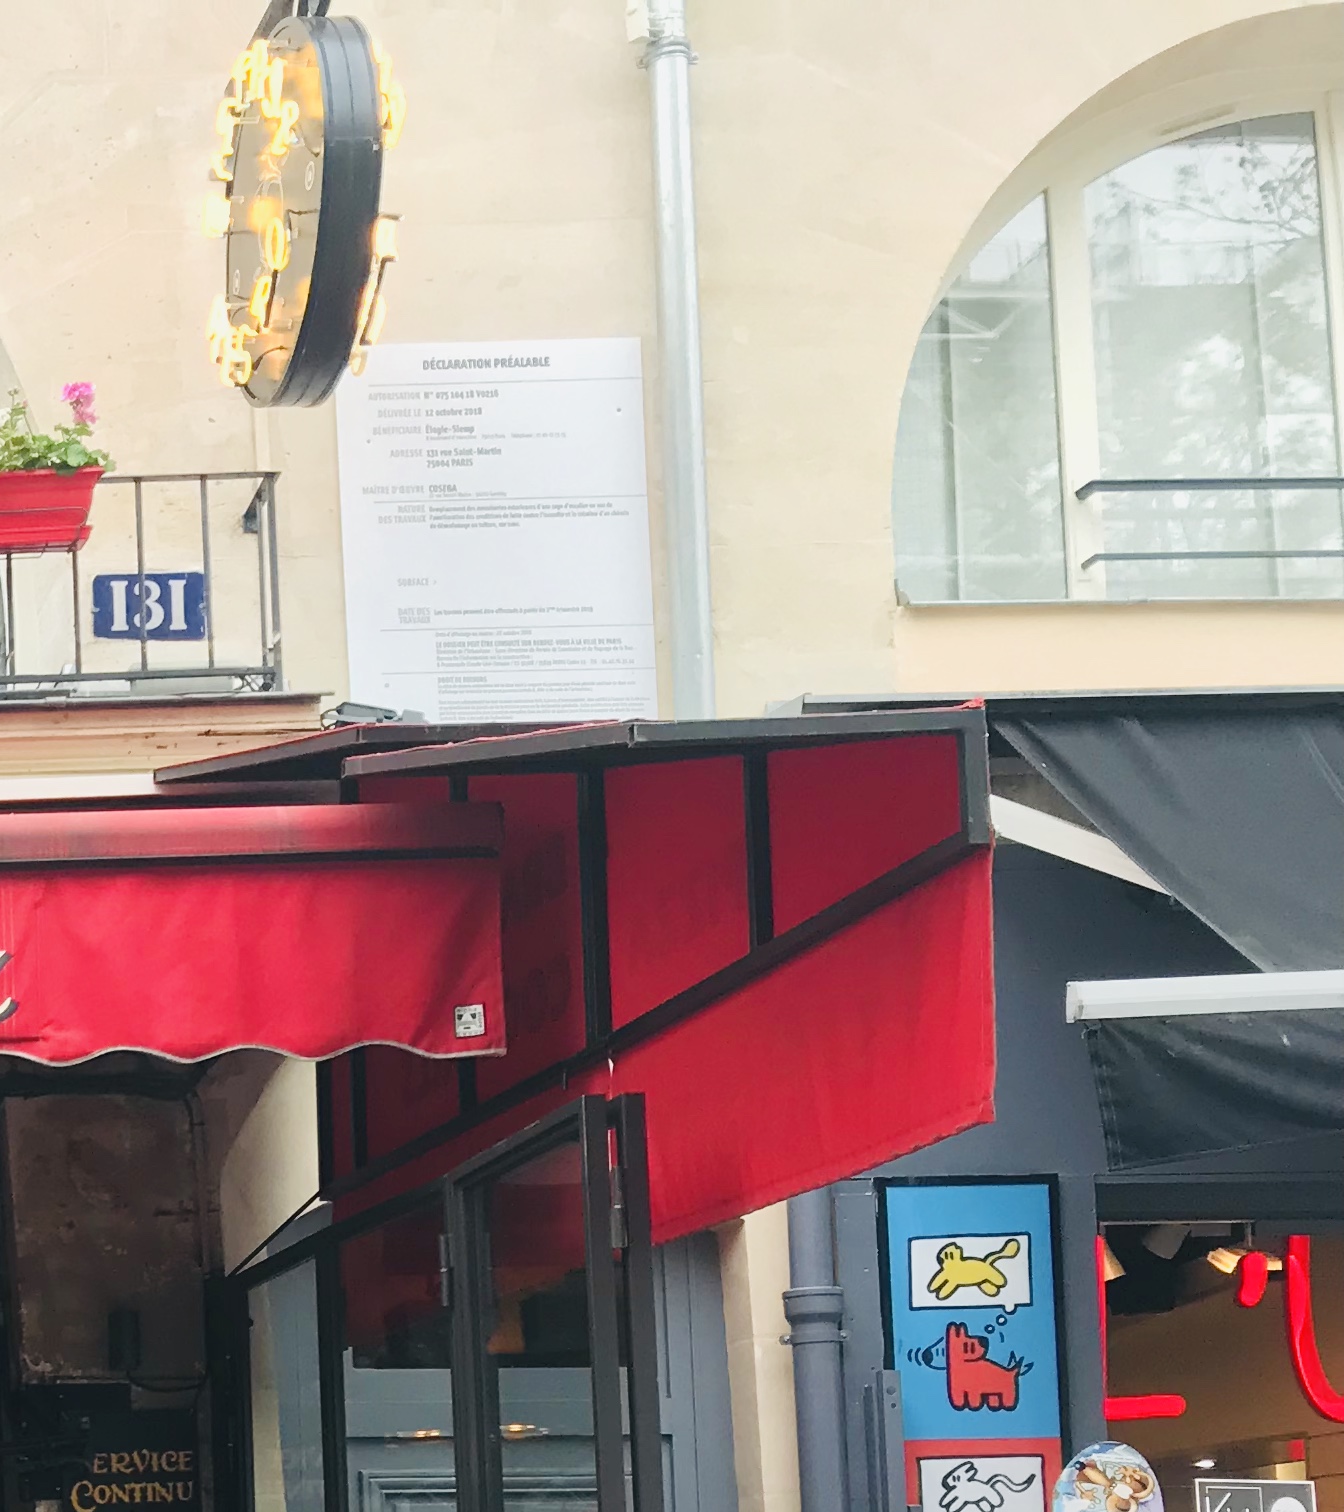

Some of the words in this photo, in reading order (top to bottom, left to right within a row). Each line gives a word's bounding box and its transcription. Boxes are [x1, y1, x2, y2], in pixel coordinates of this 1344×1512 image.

[423, 357, 492, 371] DÉCLARATION
[494, 355, 551, 369] PRÉALABLE
[425, 408, 434, 417] 12
[435, 407, 463, 417] octobre
[464, 407, 483, 417] 2018
[390, 448, 424, 458] ADRESSE
[451, 457, 474, 468] PARIS
[110, 579, 188, 631] 131
[93, 1449, 193, 1475] ERVICE
